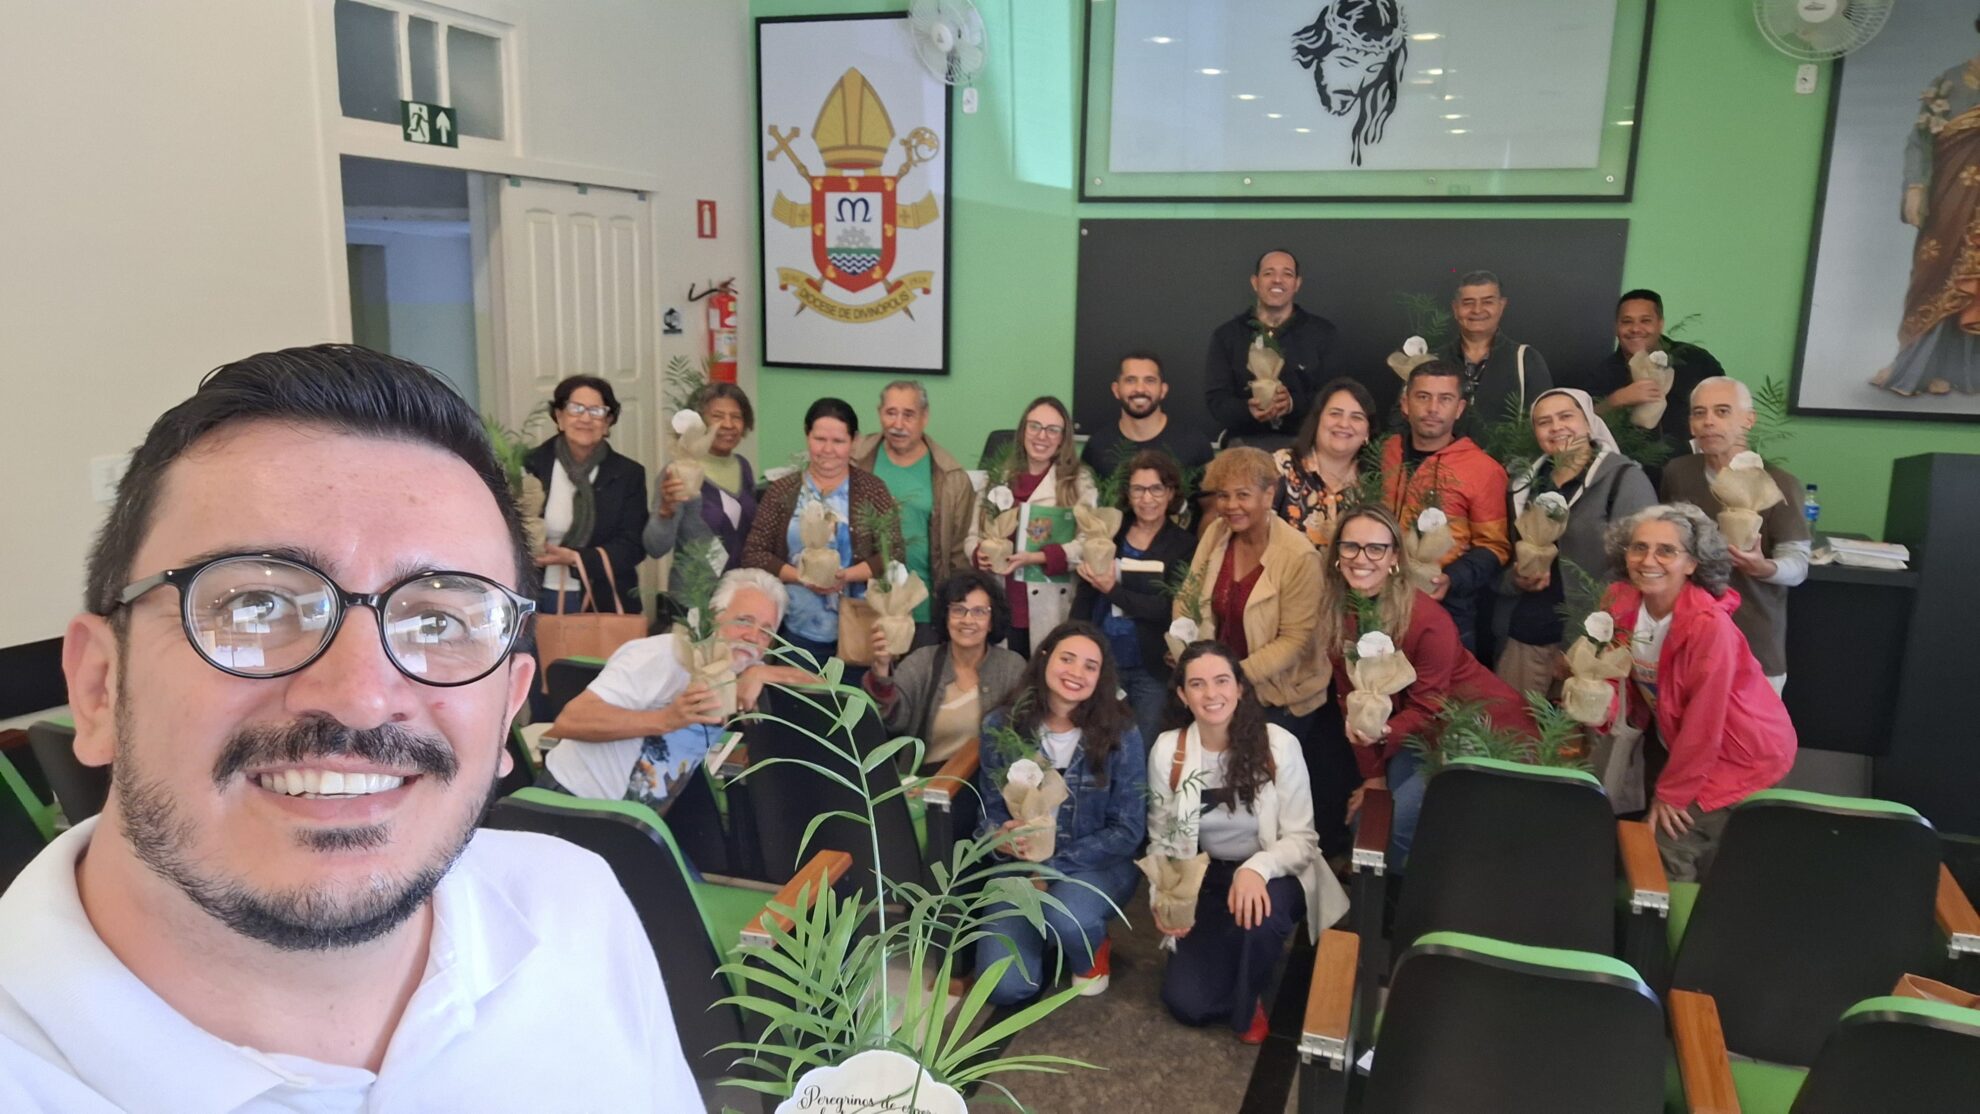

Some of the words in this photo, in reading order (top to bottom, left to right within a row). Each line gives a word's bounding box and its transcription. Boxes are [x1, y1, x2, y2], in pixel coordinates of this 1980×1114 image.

[799, 287, 837, 317] DIOCESE
[838, 306, 852, 320] DE
[798, 1085, 874, 1113] Peregrinos
[880, 1094, 895, 1110] de
